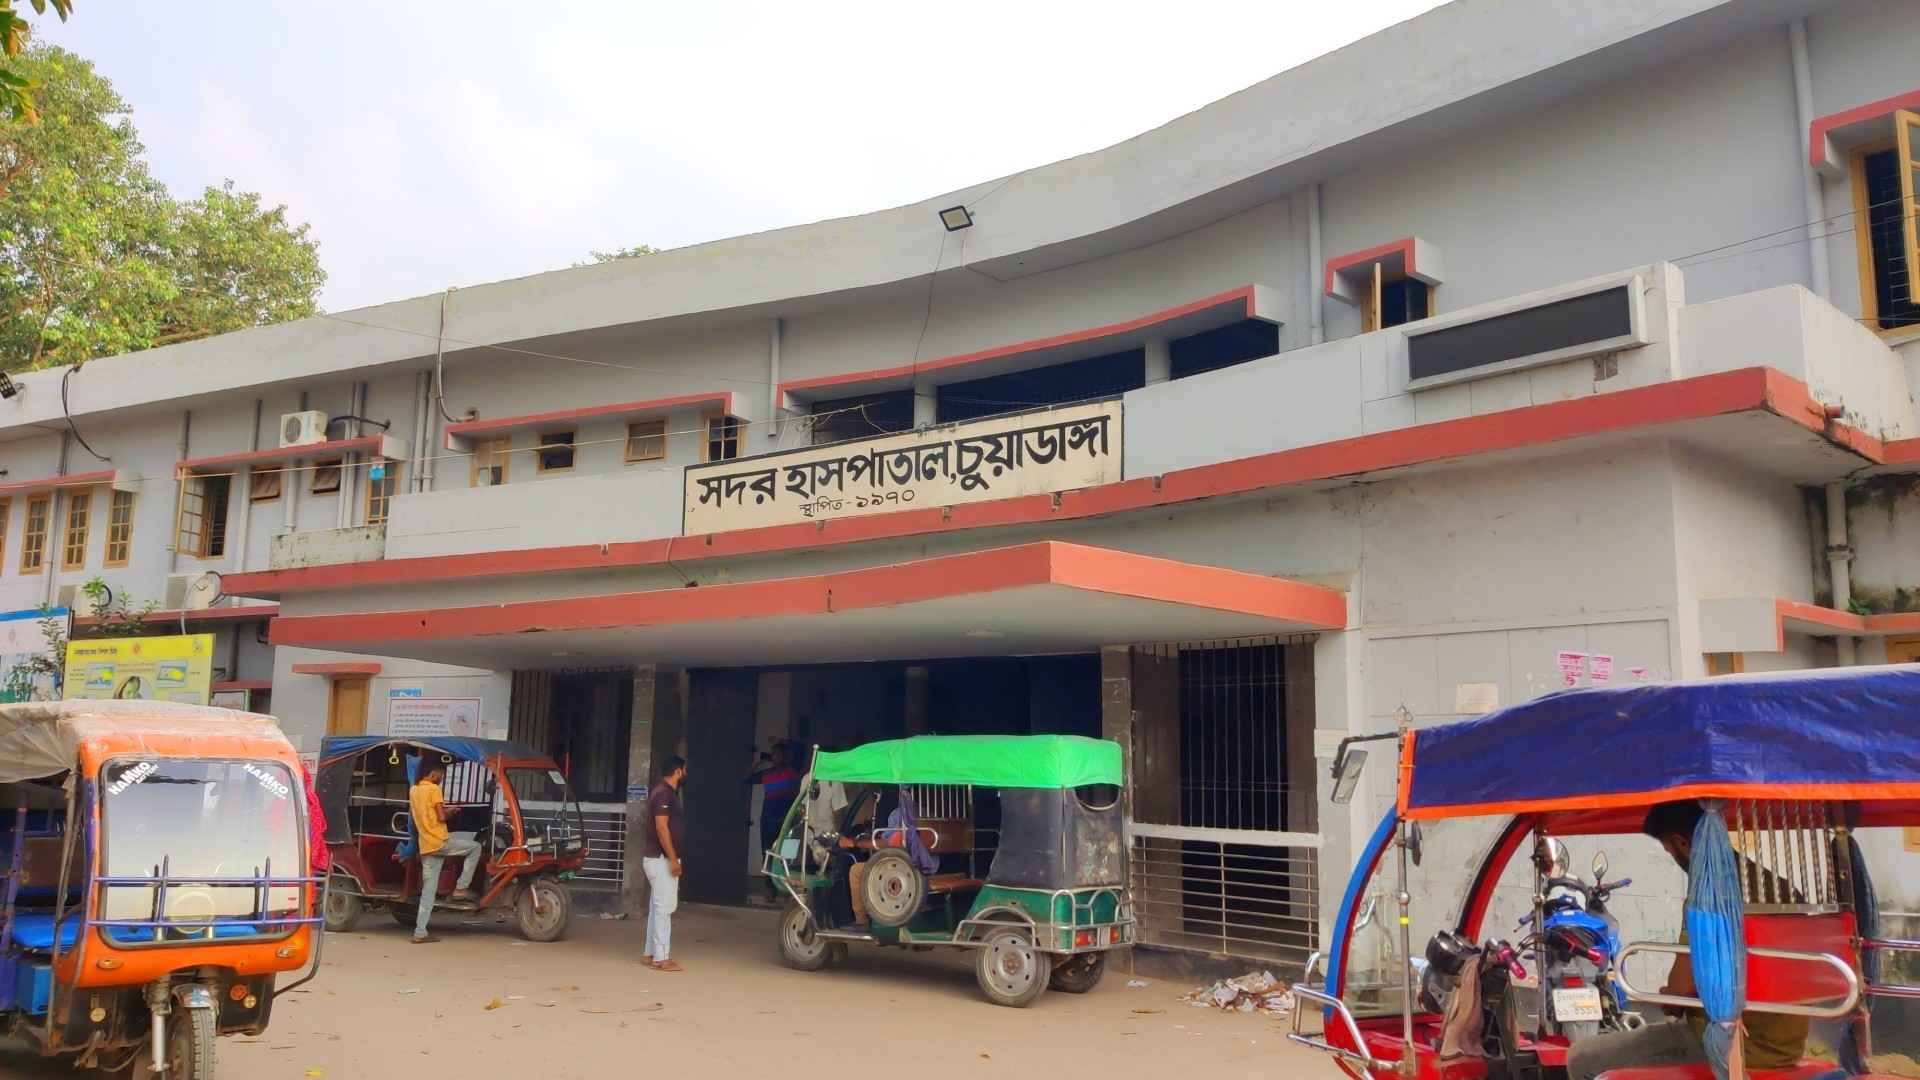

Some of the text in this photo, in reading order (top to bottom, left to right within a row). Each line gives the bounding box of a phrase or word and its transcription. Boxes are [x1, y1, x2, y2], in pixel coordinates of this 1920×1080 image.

[697, 467, 778, 508] সদর
[108, 762, 151, 795] HAMKO
[243, 763, 289, 794] HAMKO
